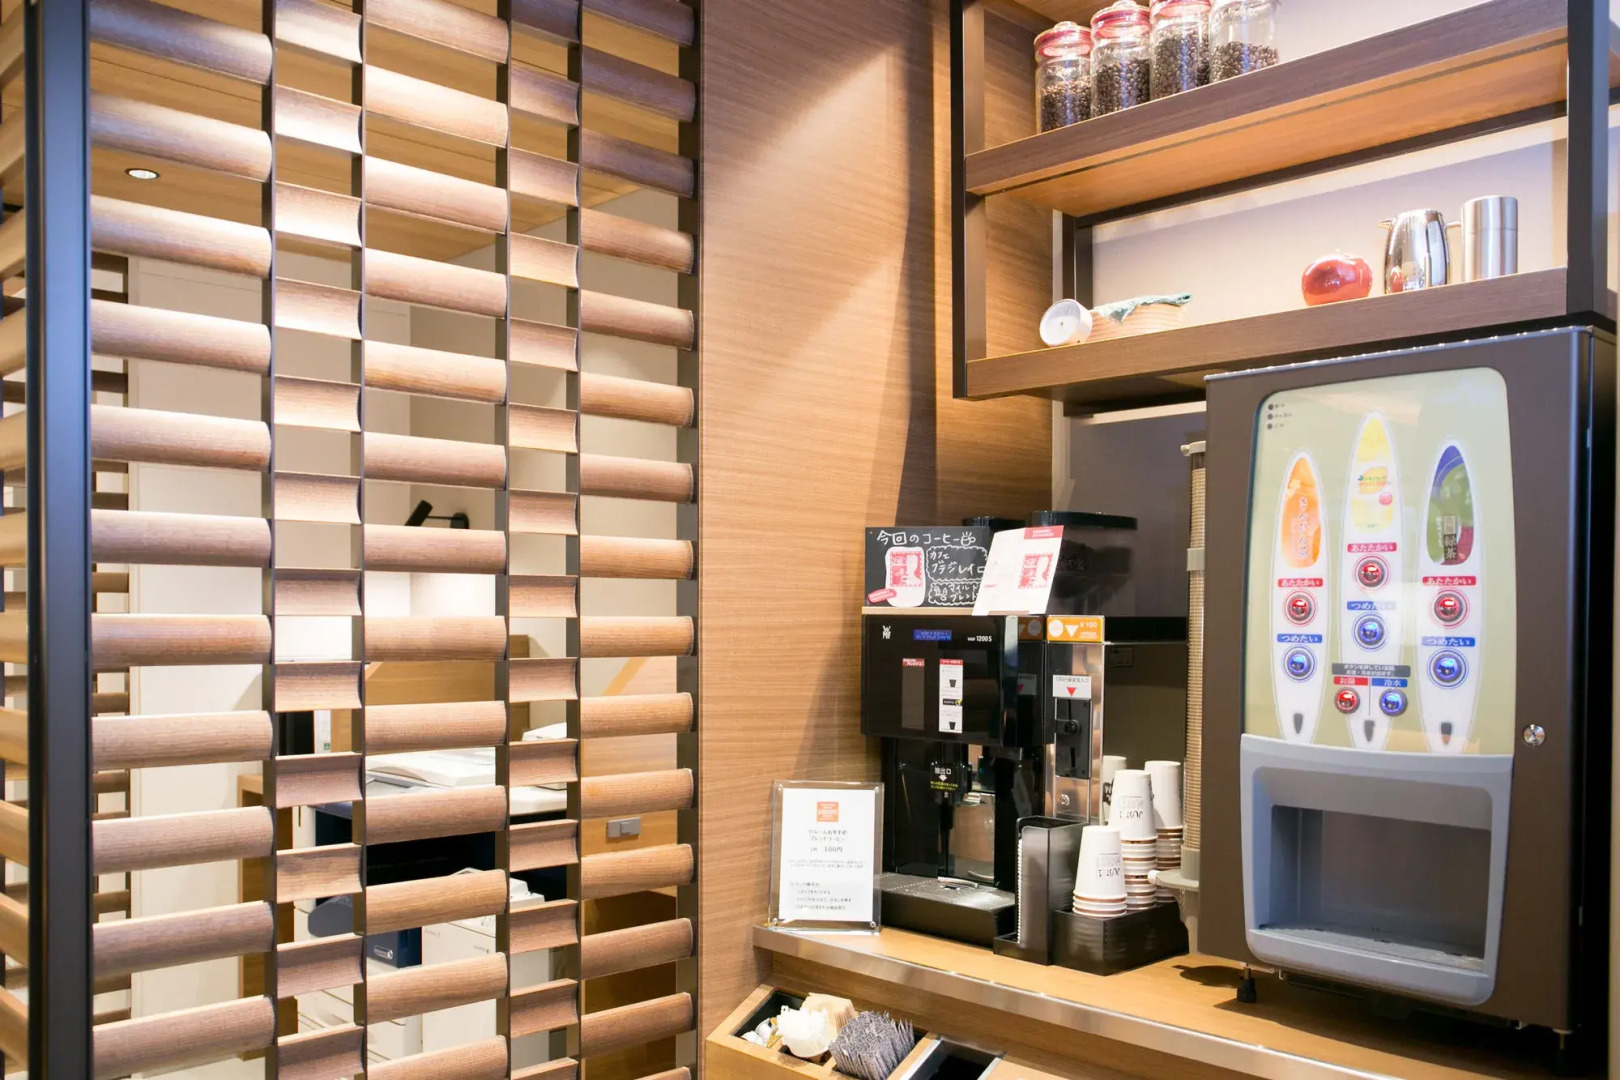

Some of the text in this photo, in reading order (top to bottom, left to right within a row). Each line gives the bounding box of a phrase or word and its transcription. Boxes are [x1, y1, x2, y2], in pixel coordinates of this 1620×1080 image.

[877, 529, 960, 546] 今回のコーヒー
[1352, 543, 1394, 551] あたたかい
[930, 551, 949, 560] カフェ
[1281, 579, 1319, 587] あたたかい
[1428, 577, 1472, 585] あたたかい
[948, 583, 979, 593] マイルド
[950, 592, 979, 602] ブレンド
[1281, 635, 1319, 643] つめたい
[1427, 638, 1471, 646] つめたい
